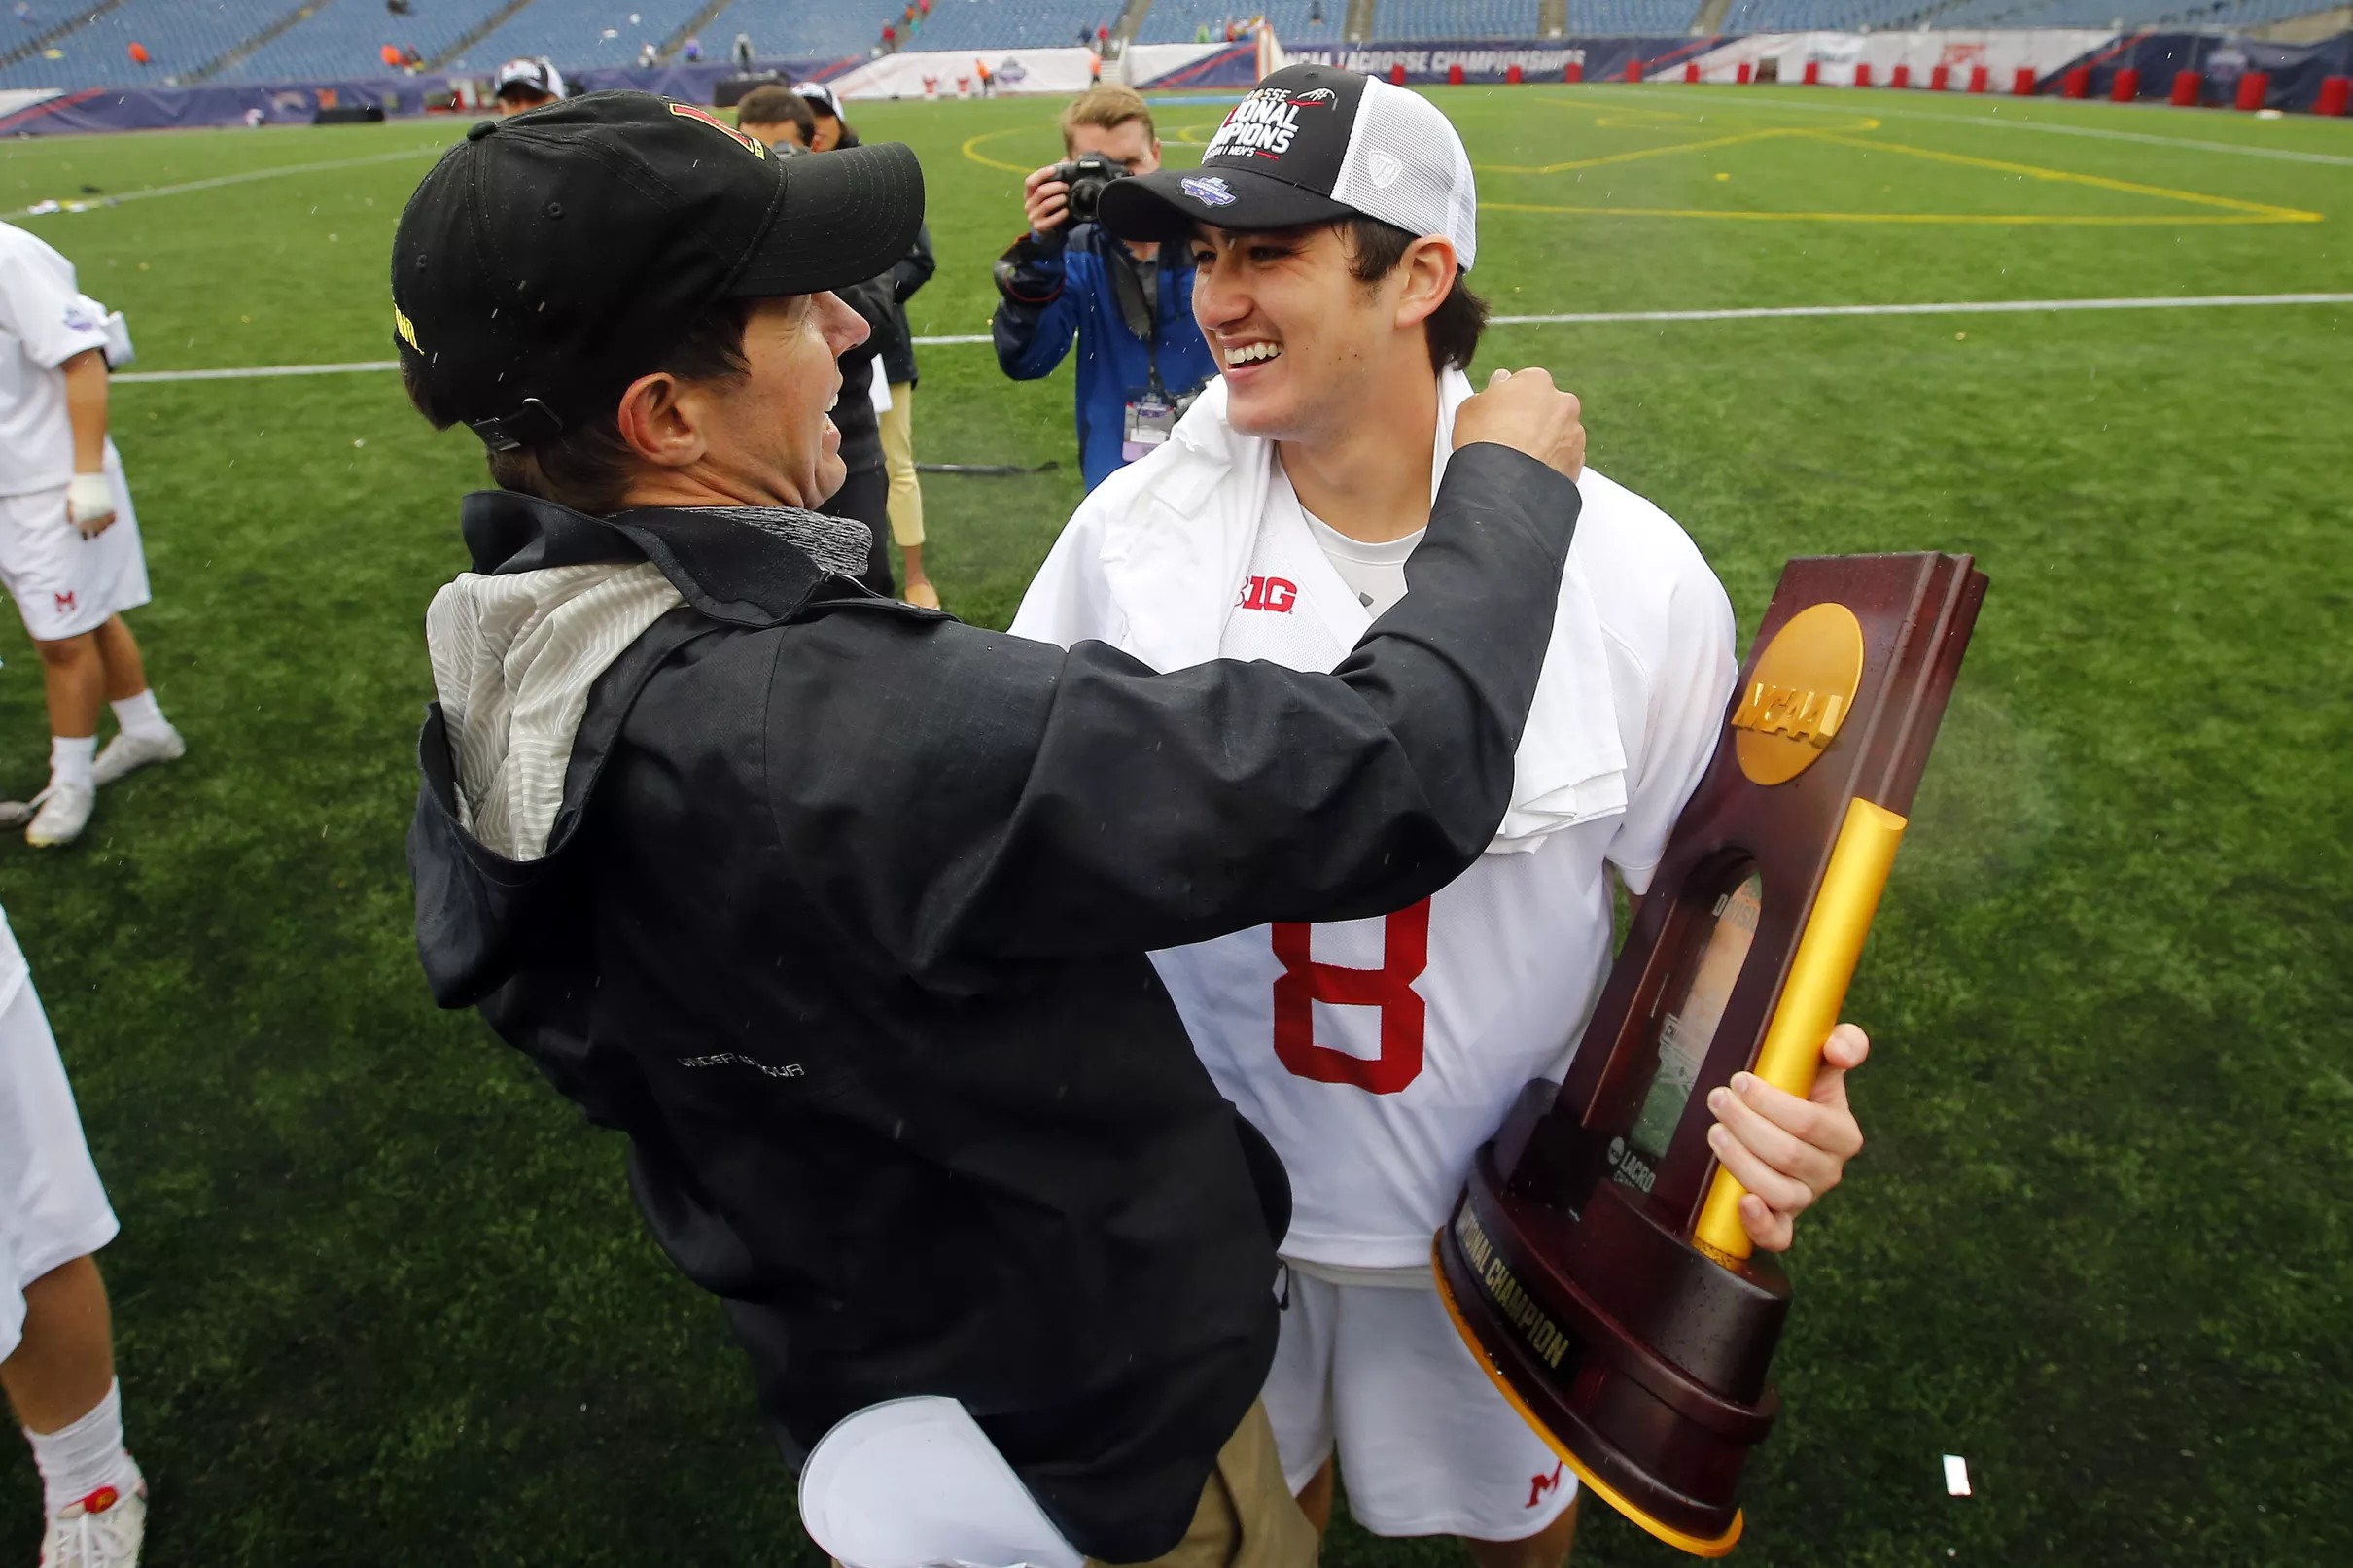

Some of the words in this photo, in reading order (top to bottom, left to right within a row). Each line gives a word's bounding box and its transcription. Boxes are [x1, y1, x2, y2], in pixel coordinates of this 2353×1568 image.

[1337, 50, 1429, 73] LACROSSE
[1431, 50, 1586, 73] CHAMPIONSHIPS
[1731, 682, 1843, 749] NCAA
[1271, 895, 1431, 1095] 8
[1484, 1257, 1570, 1370] CHAMPION
